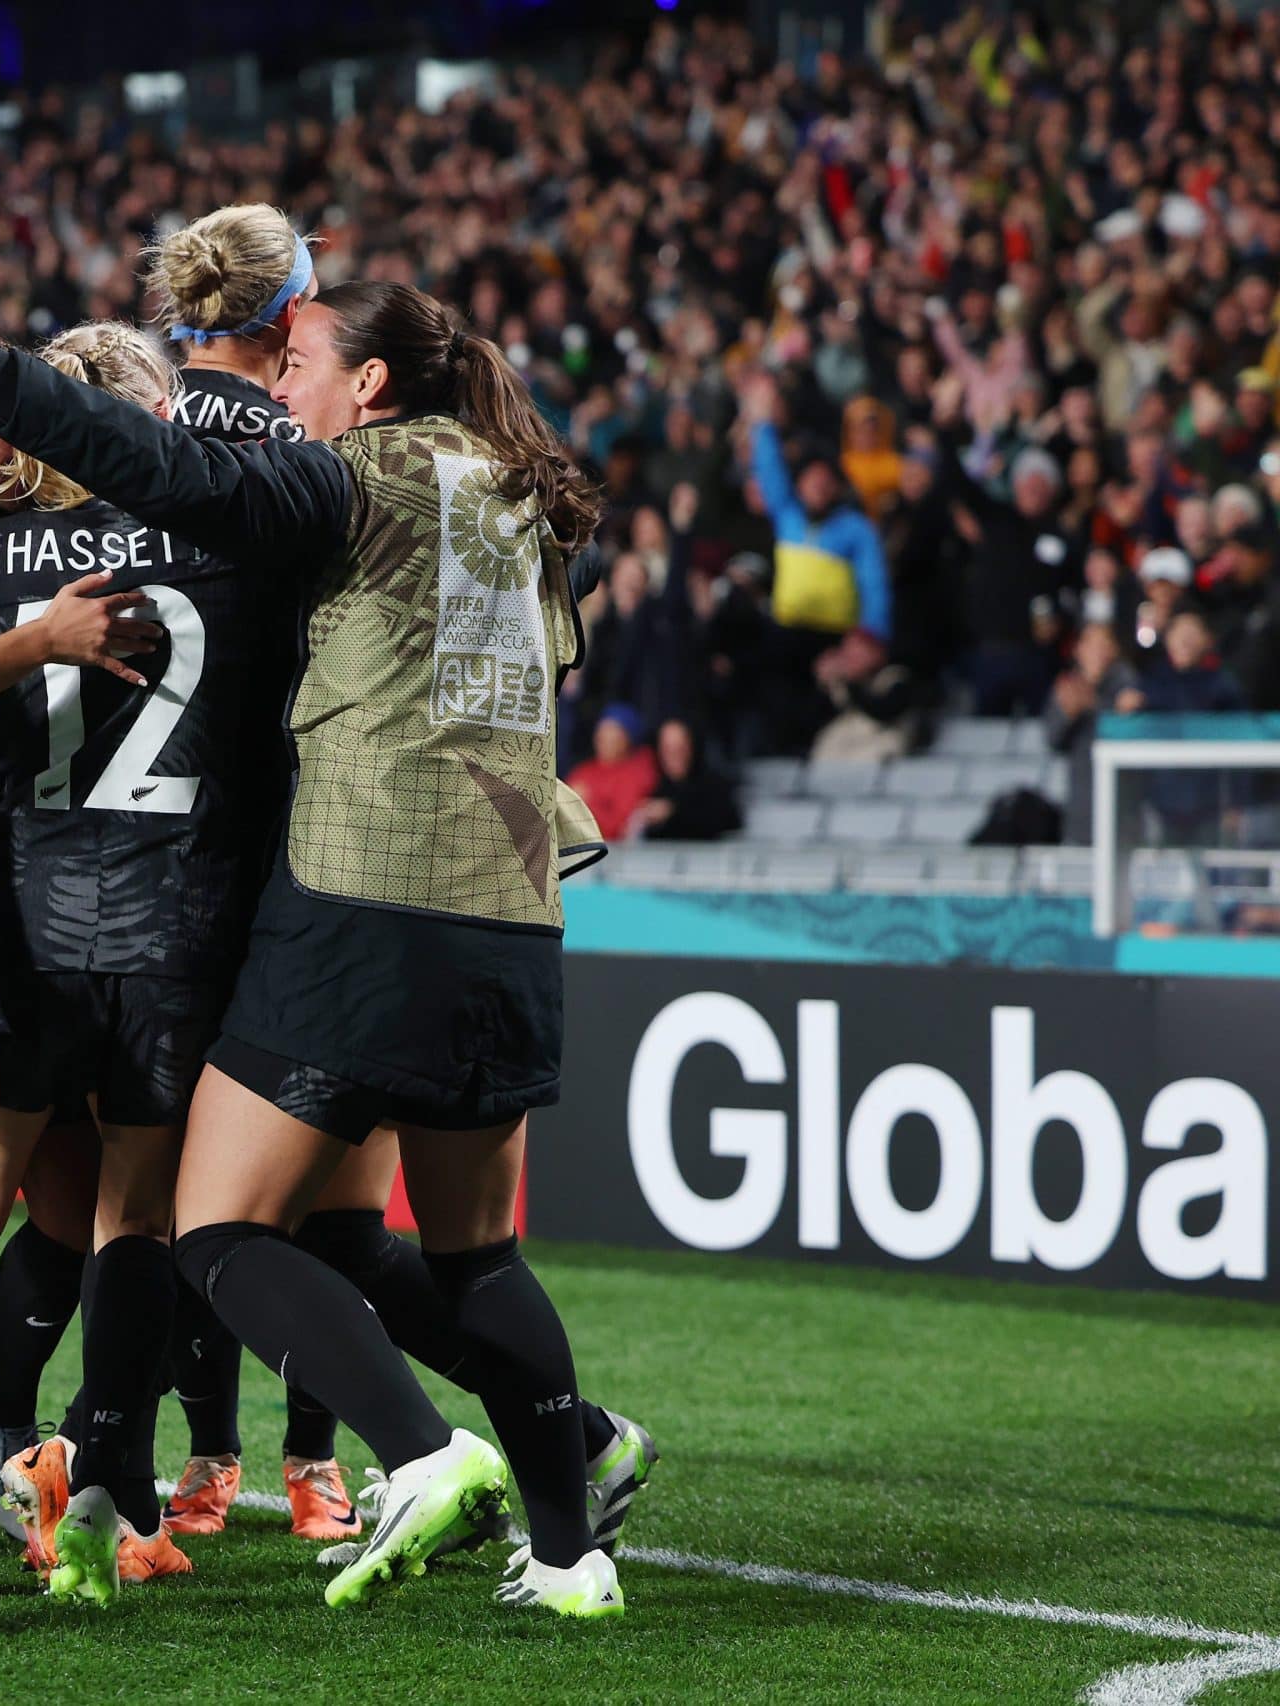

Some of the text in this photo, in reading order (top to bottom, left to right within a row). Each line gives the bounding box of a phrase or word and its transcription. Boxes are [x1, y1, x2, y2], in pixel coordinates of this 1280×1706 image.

[446, 596, 484, 613] FIFA
[444, 614, 521, 633] WOMEN'S
[442, 631, 536, 650] WORLD CUP
[15, 584, 205, 814] 12
[626, 990, 1269, 1282] Globa
[535, 1393, 573, 1416] NZ
[93, 1410, 123, 1425] NZ
